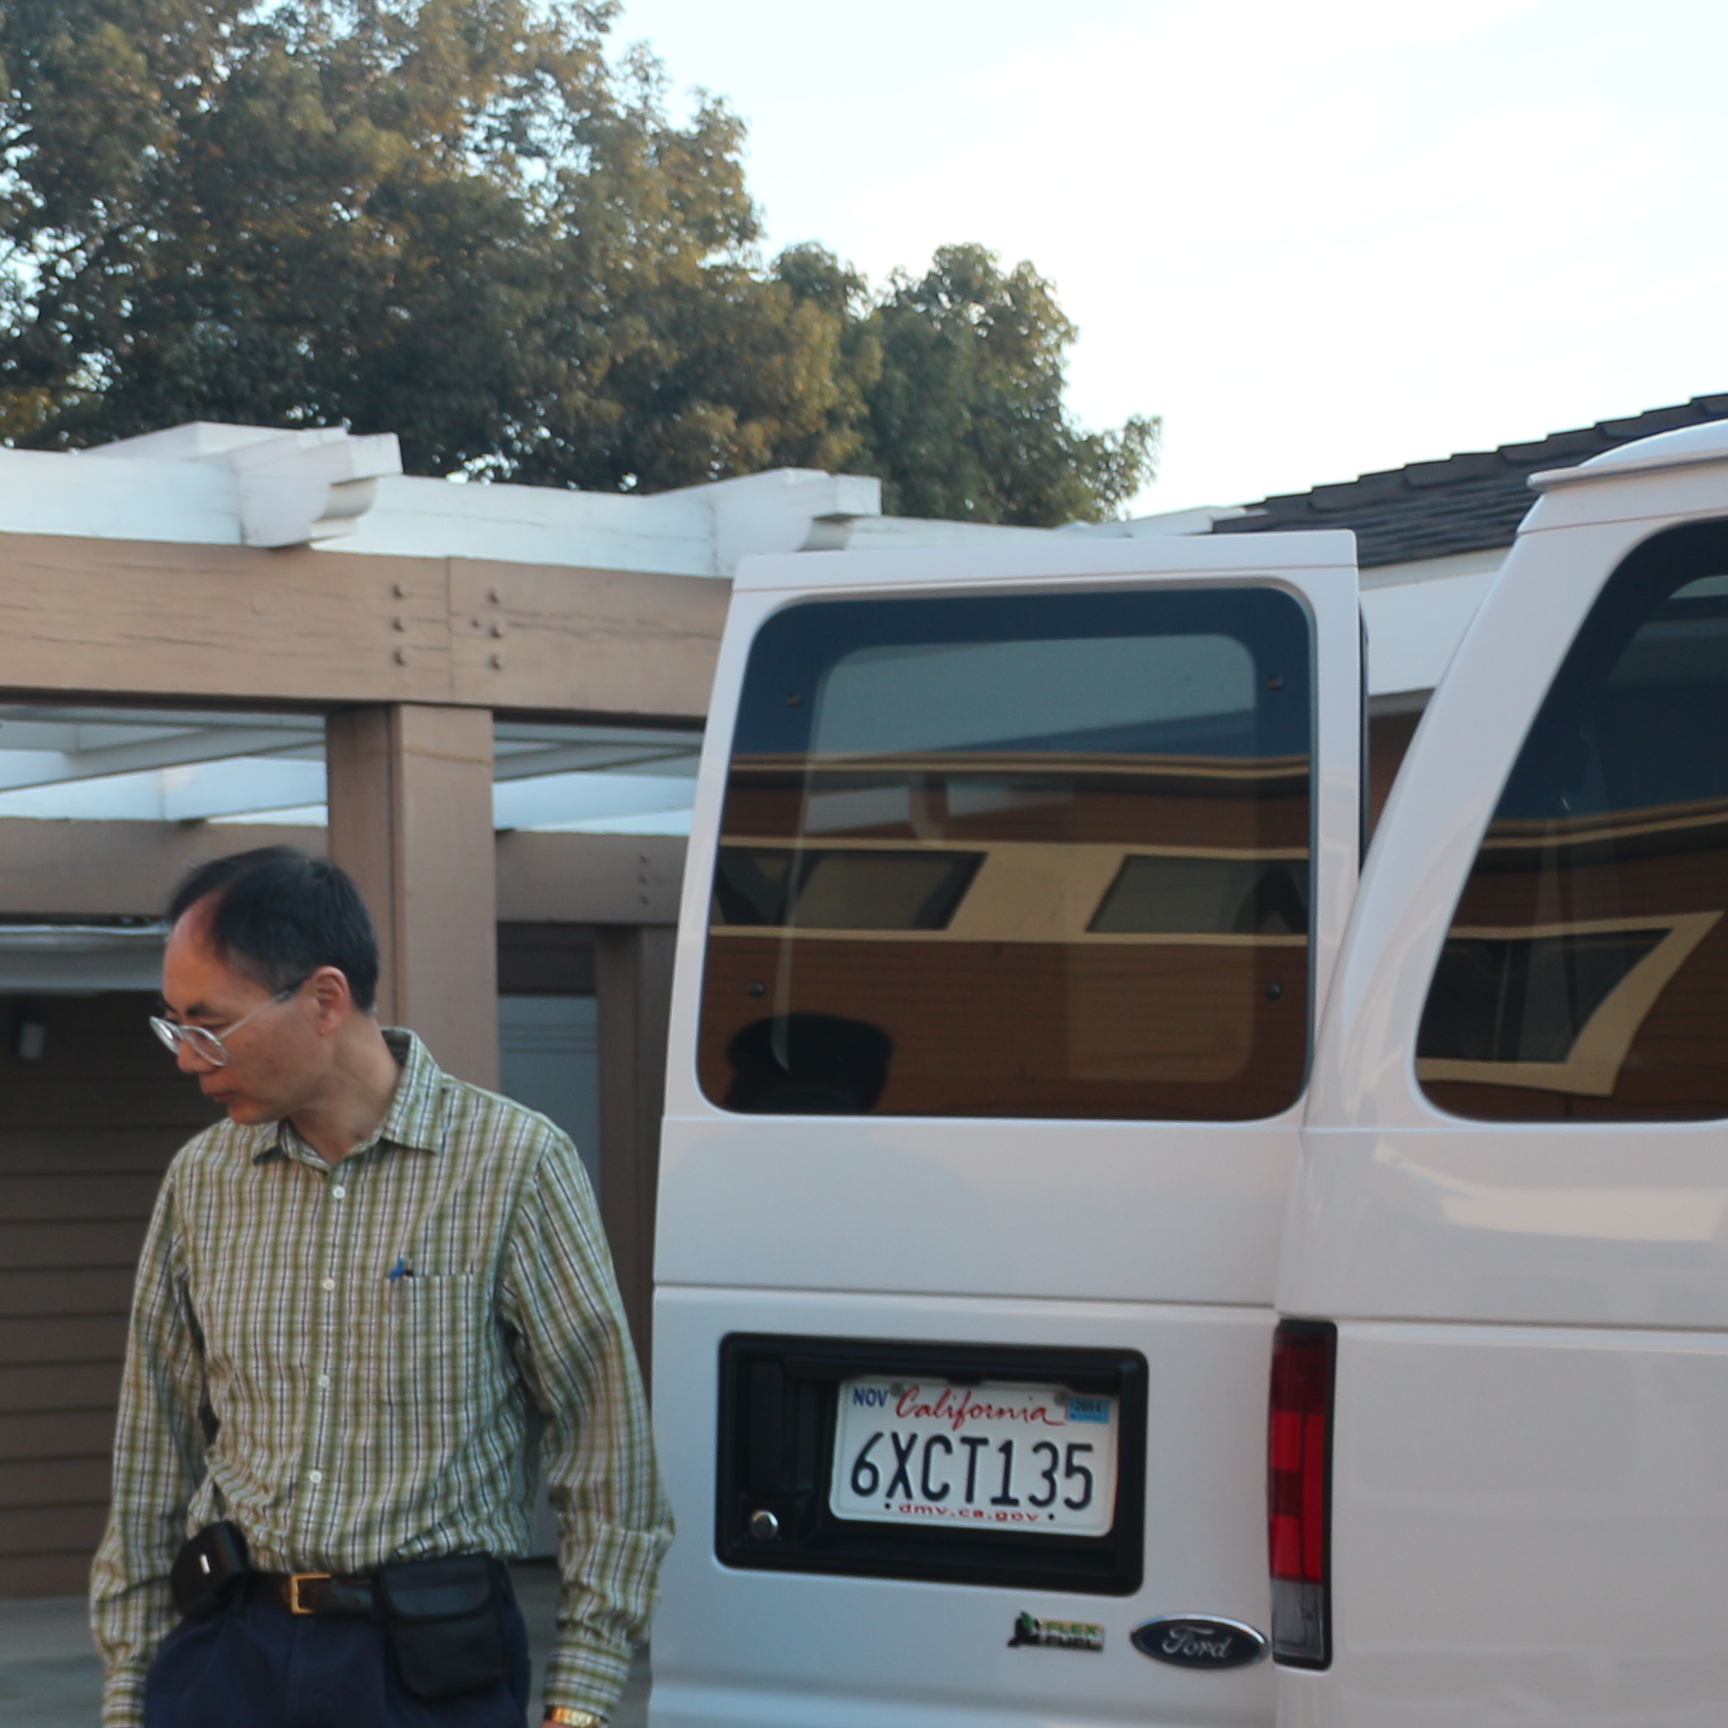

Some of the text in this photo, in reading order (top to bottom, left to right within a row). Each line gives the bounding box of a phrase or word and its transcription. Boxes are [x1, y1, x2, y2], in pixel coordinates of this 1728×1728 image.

[853, 1387, 888, 1407] NOV
[895, 1385, 1066, 1431] California
[851, 1432, 1093, 1510] 6XCT135
[898, 1503, 1040, 1522] dmv.ca.gov
[1046, 1621, 1096, 1635] FLEX
[1162, 1626, 1234, 1659] Ford
